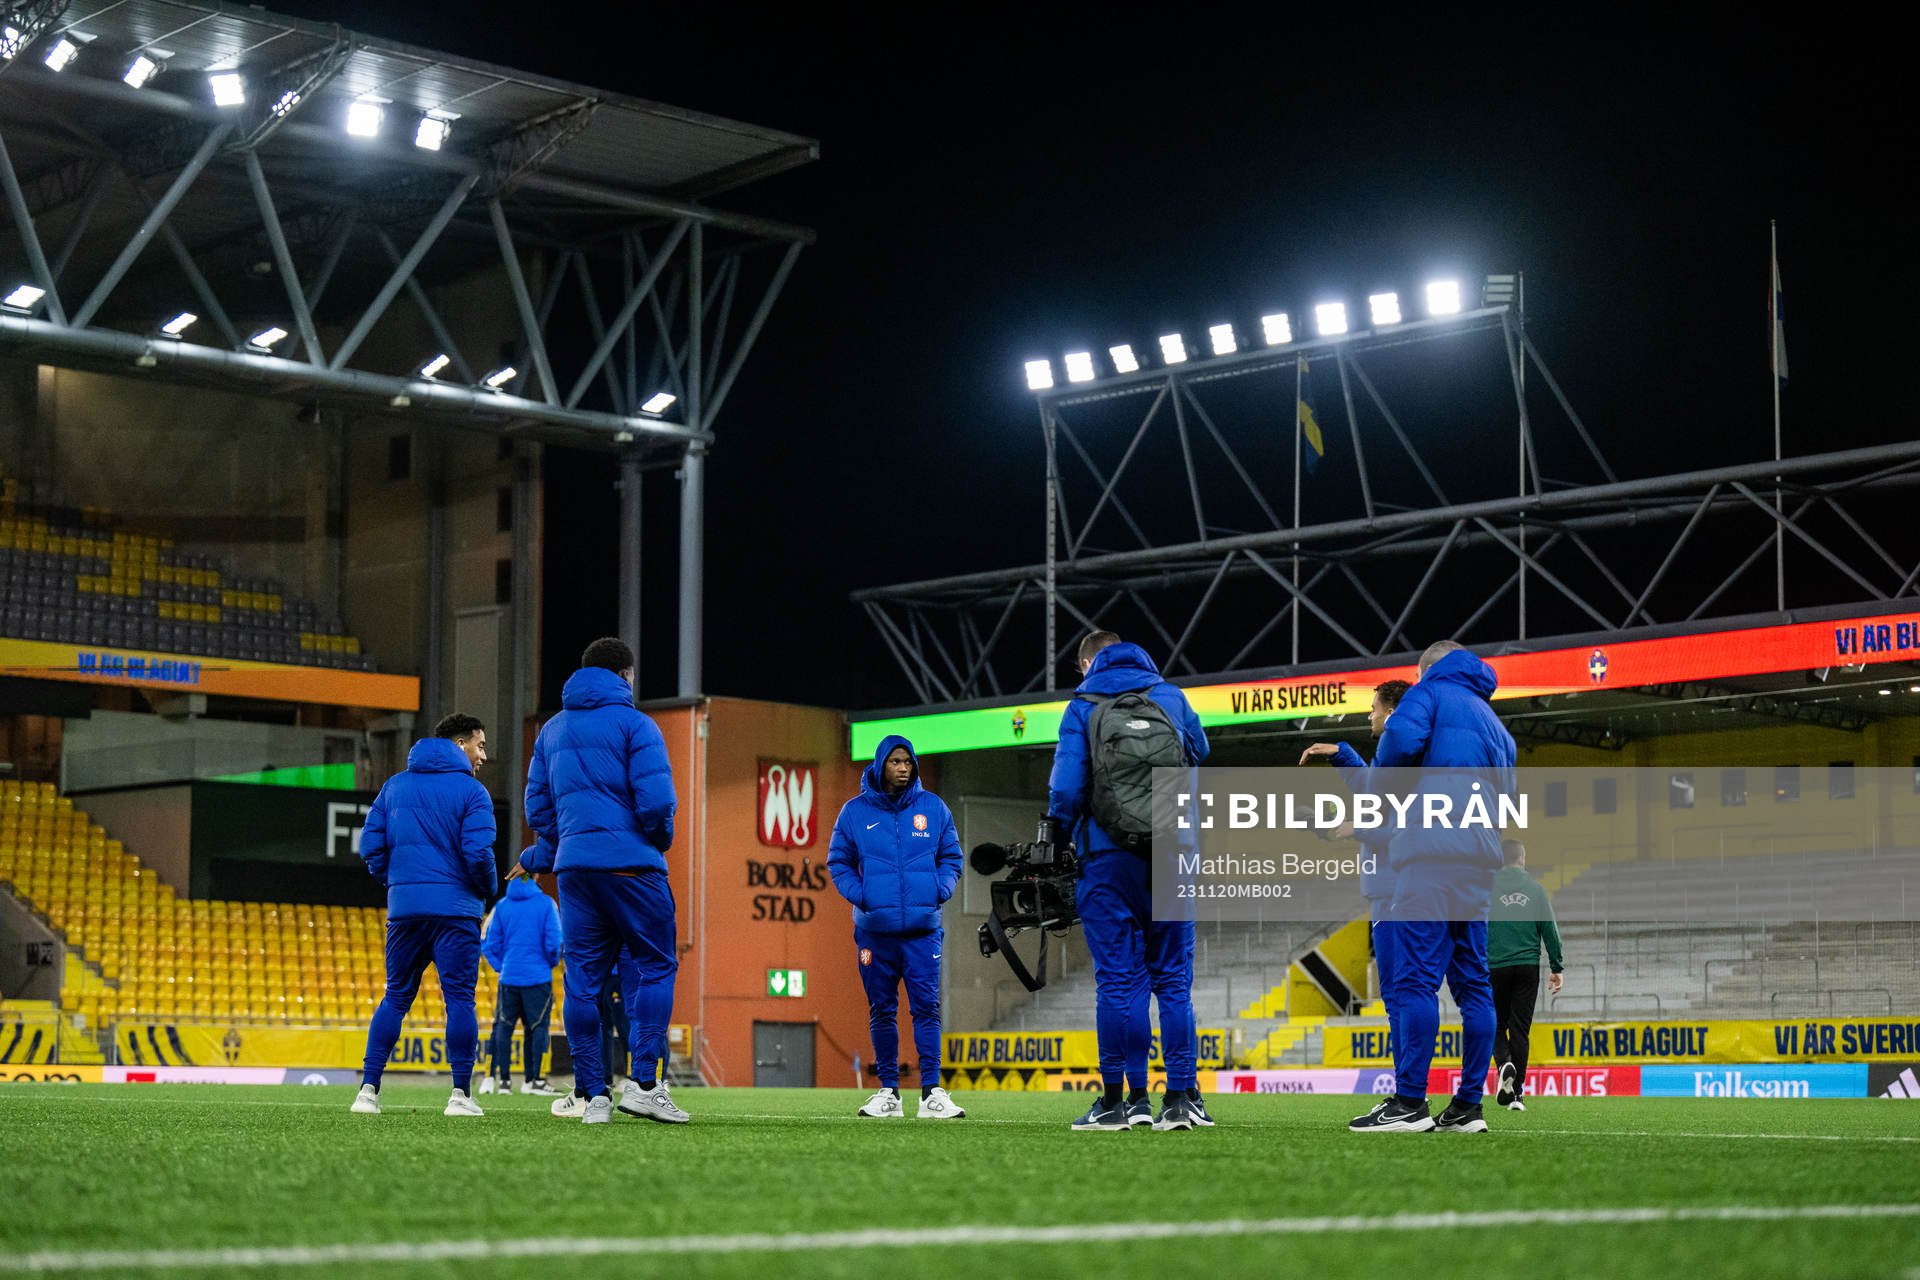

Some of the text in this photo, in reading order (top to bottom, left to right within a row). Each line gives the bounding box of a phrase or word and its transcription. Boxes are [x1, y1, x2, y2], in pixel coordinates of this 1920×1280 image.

[1836, 628, 1857, 655] VI
[1232, 682, 1346, 713] VI ÄR SVERIGE
[747, 858, 827, 891] BORÅS
[752, 895, 815, 923] STAD
[1501, 895, 1527, 905] UEFA
[391, 1037, 424, 1064] EJA
[948, 1038, 963, 1063] VI
[968, 1036, 989, 1062] ÄR
[1553, 1026, 1708, 1057] VI ÄR BLÅGULT
[1774, 1025, 1798, 1055] VI
[1803, 1023, 1836, 1054] ÄR
[1261, 1082, 1313, 1093] SVENSKA
[1694, 1071, 1809, 1097] Folksam
